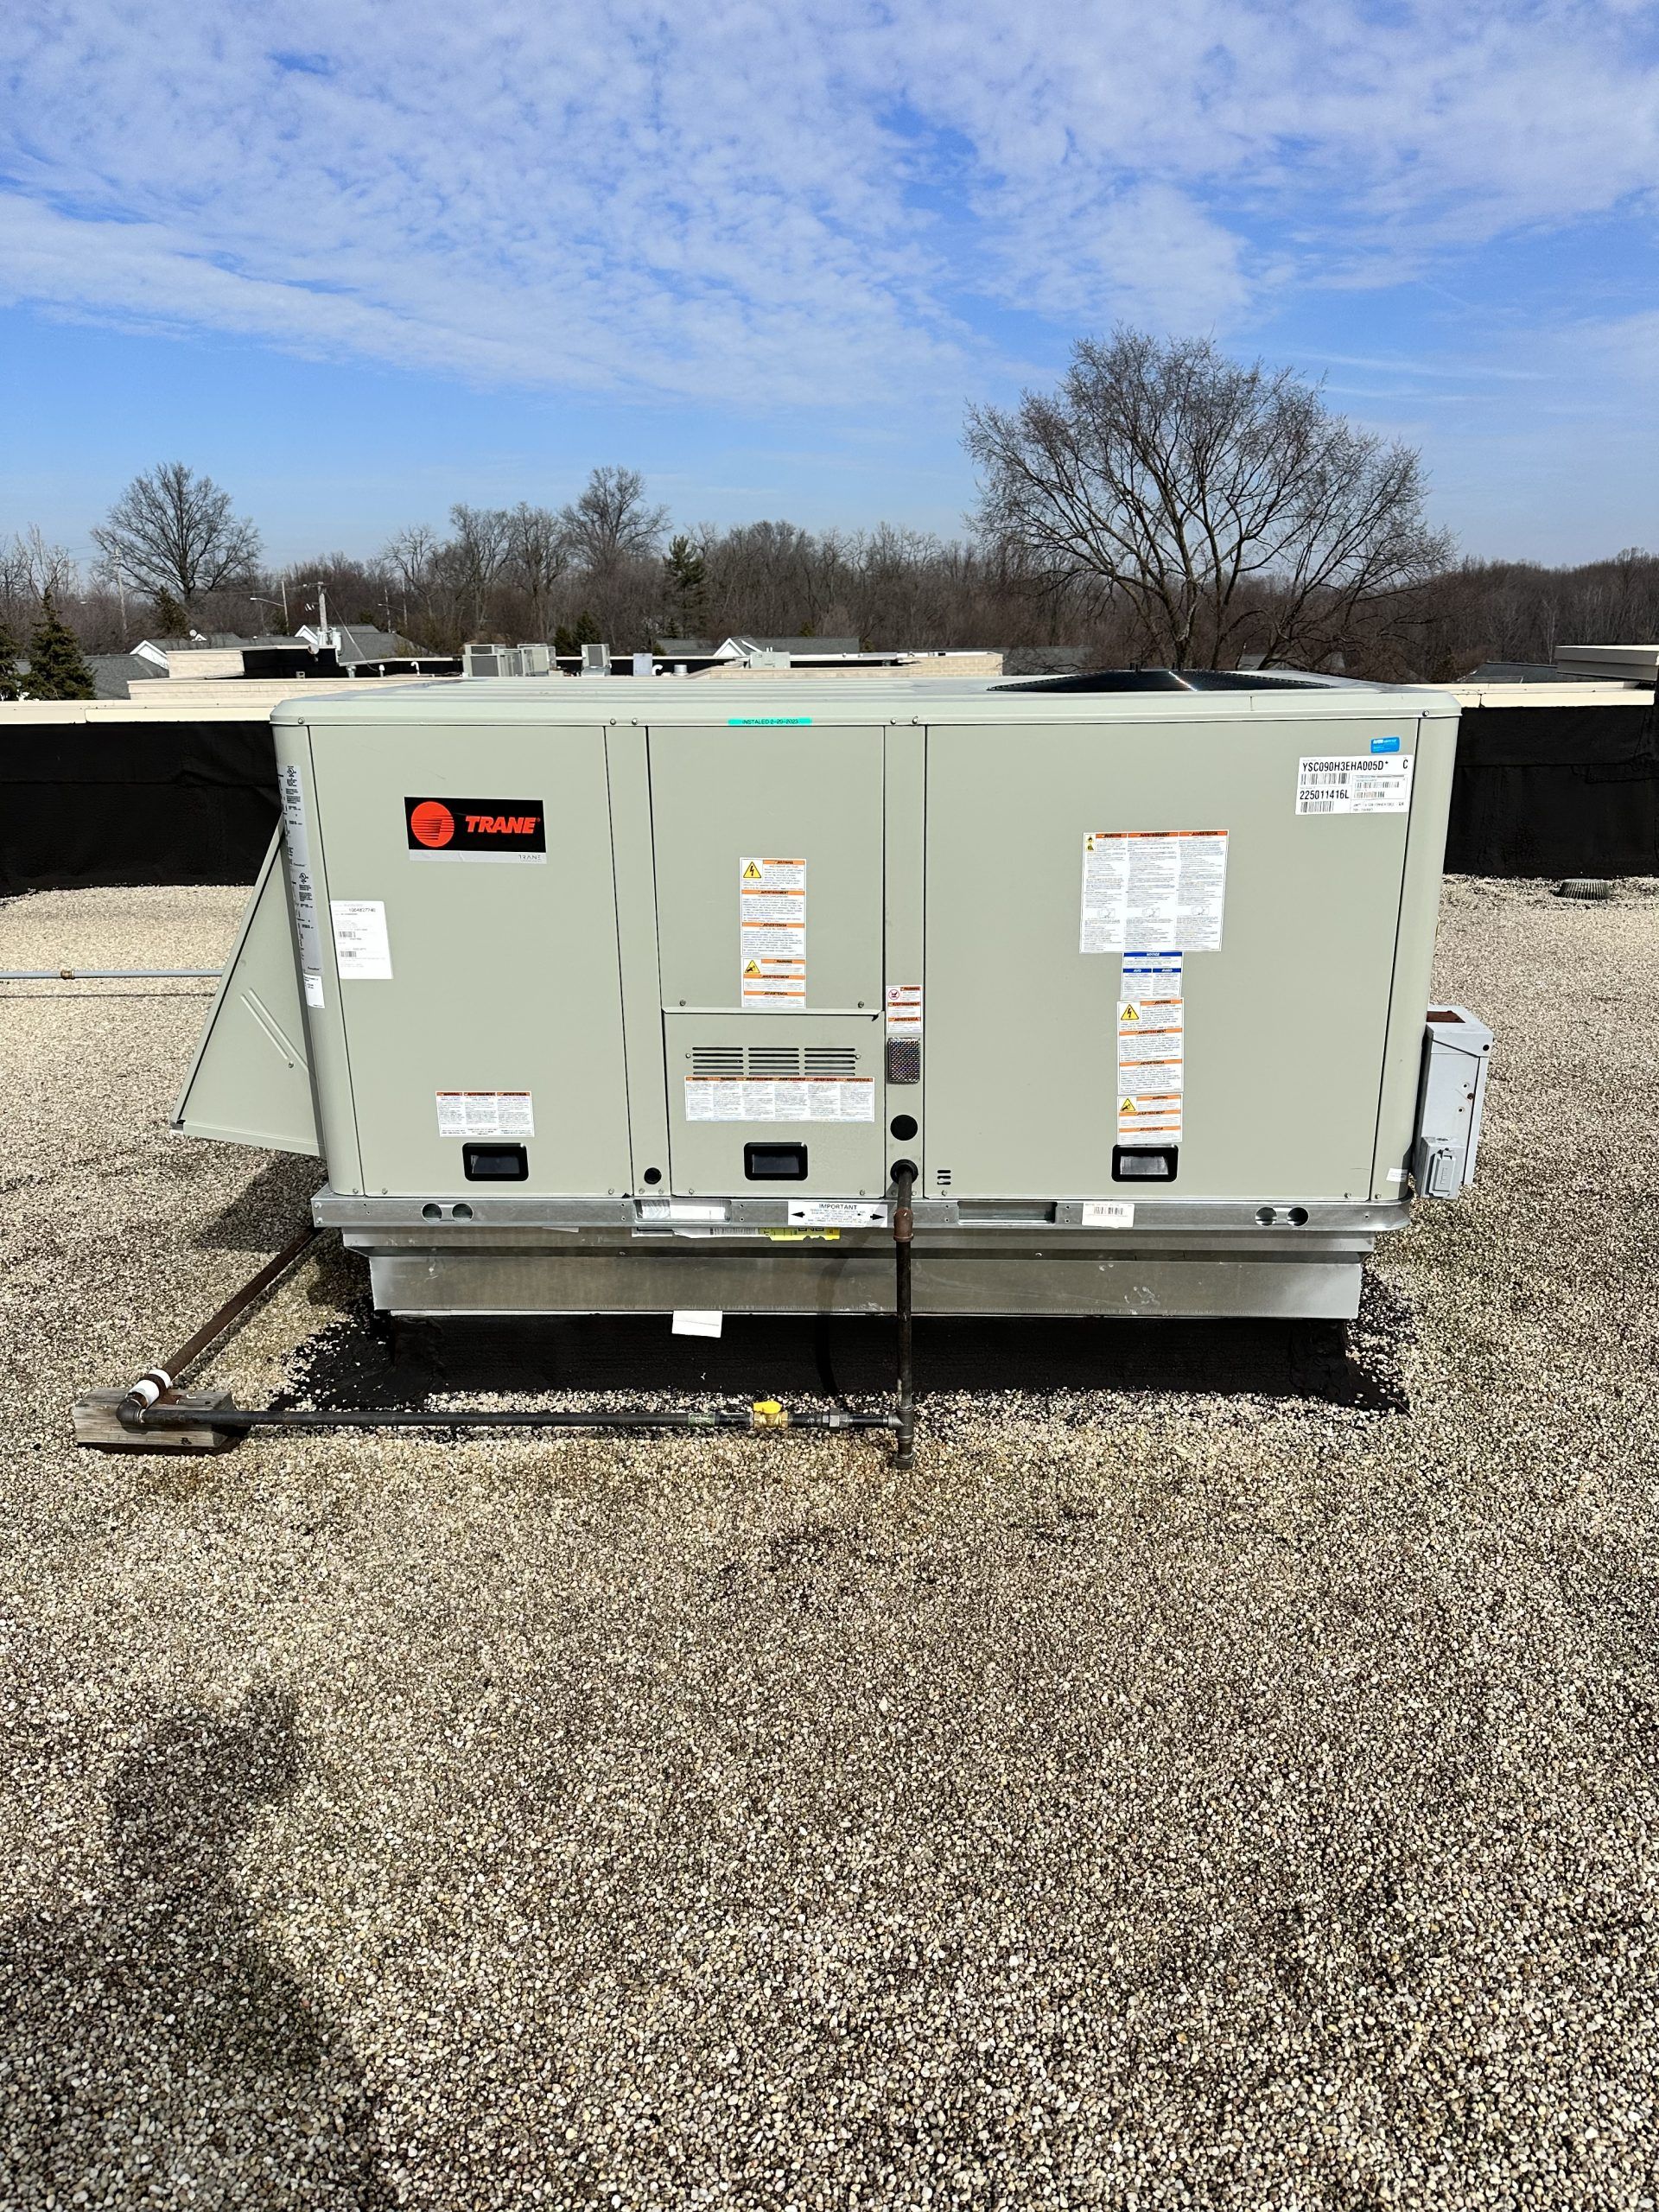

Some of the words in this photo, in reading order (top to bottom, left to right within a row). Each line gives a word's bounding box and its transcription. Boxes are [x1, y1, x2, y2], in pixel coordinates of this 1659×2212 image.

[1403, 759, 1408, 769] C
[1300, 790, 1350, 800] 225011416L
[465, 816, 537, 834] TRANE
